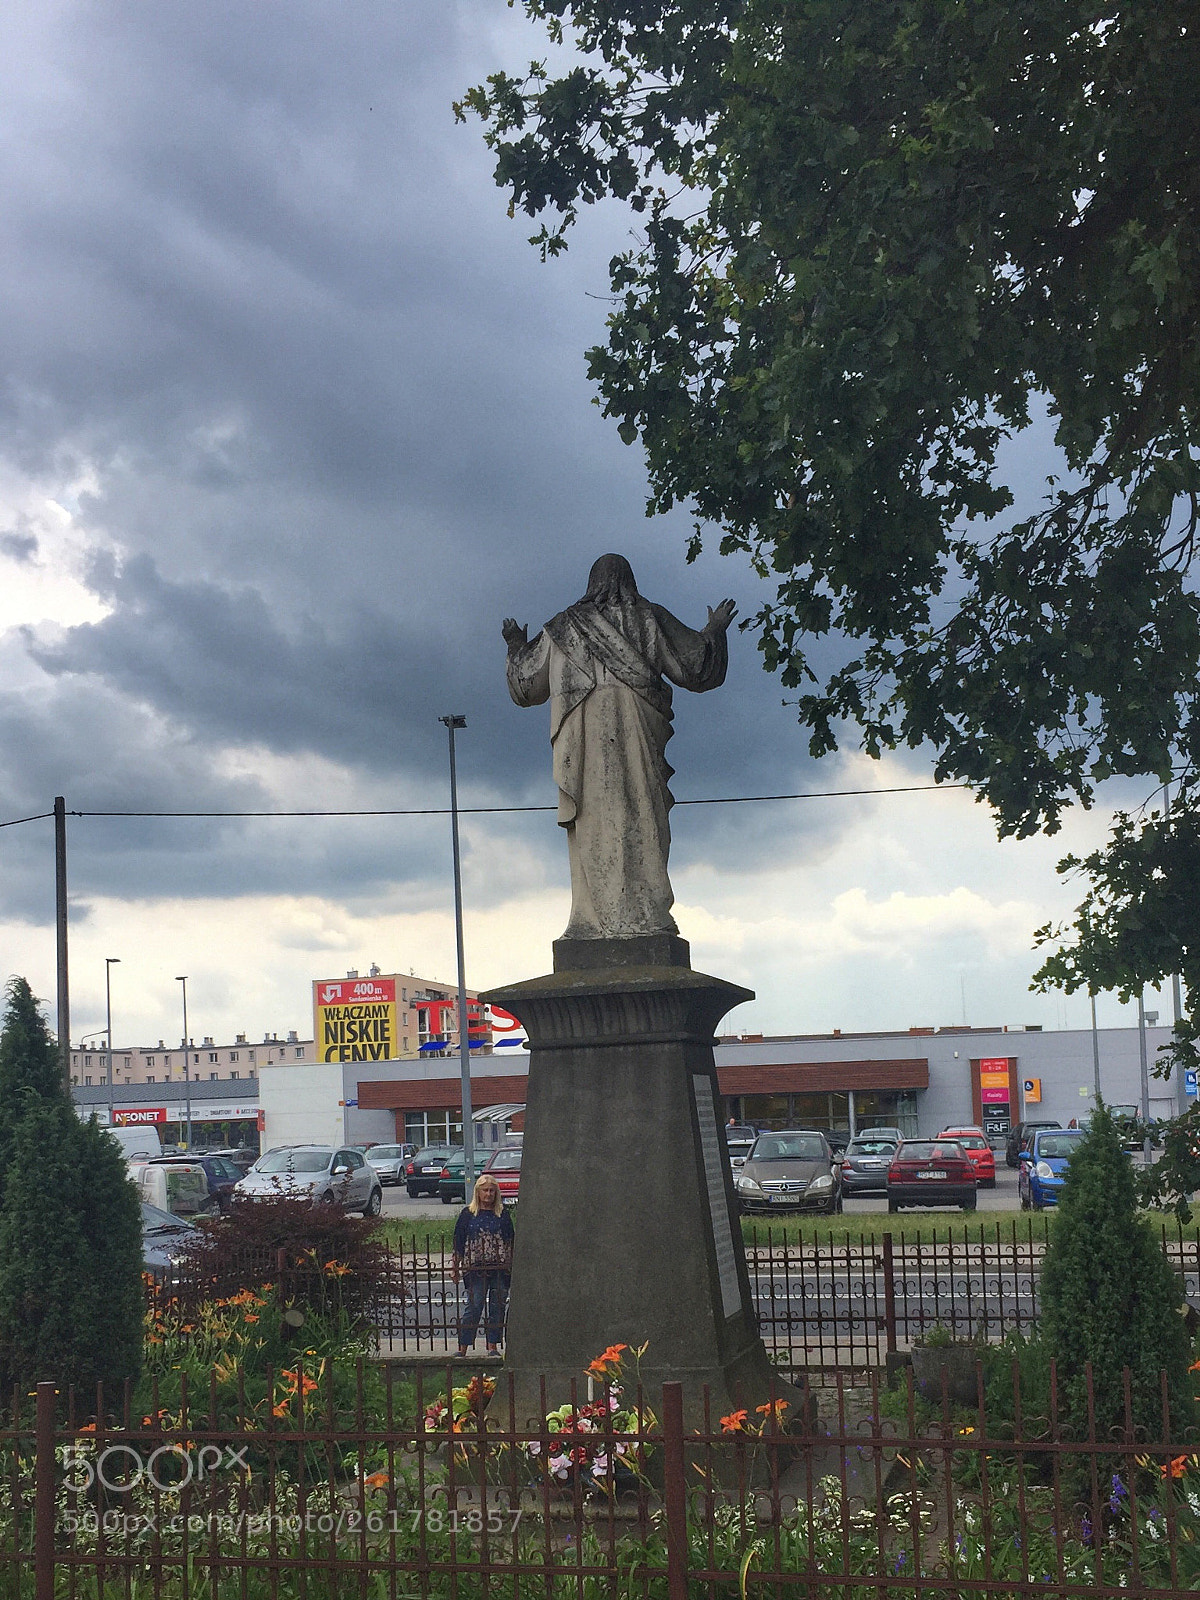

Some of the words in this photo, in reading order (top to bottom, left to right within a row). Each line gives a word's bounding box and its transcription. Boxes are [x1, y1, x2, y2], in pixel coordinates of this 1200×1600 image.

[354, 983, 374, 995] 400
[324, 1019, 391, 1044] NISKIE
[115, 1111, 160, 1123] NEONET
[986, 1122, 1008, 1133] F&F
